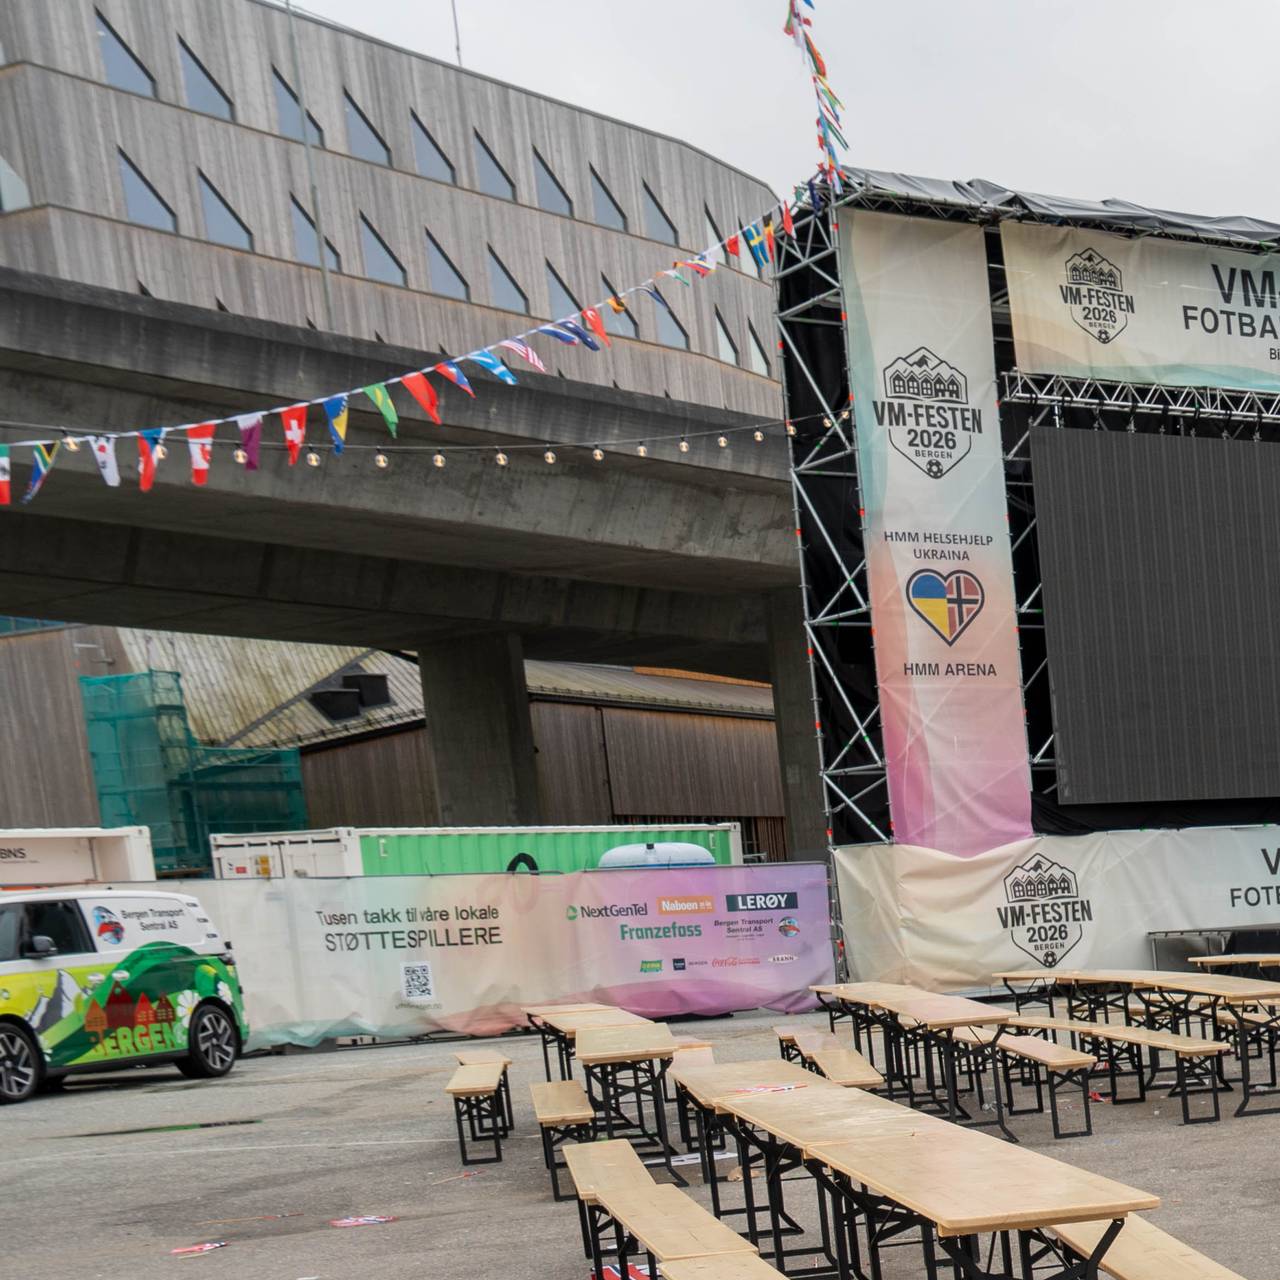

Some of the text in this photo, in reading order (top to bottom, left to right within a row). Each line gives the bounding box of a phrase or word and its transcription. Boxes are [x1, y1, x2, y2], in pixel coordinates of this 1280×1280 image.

[1059, 285, 1135, 314] VM-FESTEN
[1082, 306, 1117, 324] 2026
[1088, 321, 1116, 330] BERGEN
[872, 400, 983, 434] VM-FESTEN
[907, 429, 957, 450] 2026
[915, 449, 953, 459] BERGEN
[884, 531, 993, 546] HMM HELSEHJELP
[913, 549, 970, 561] UKRAINA
[904, 663, 997, 677] HMM ARENA
[738, 894, 787, 910] LERØY
[121, 909, 150, 920] Bergen
[149, 908, 185, 920] Transport
[316, 905, 500, 926] Tusen takk til våre lokale
[581, 903, 648, 918] NextGenTel
[997, 900, 1093, 929] VM-FESTEN
[140, 921, 179, 931] Sentral AS
[714, 919, 739, 927] Bergen
[620, 921, 702, 941] Franzefoss
[1027, 924, 1068, 943] 2026
[325, 927, 503, 952] STØTTESPILLERE
[1034, 942, 1065, 951] BERGEN
